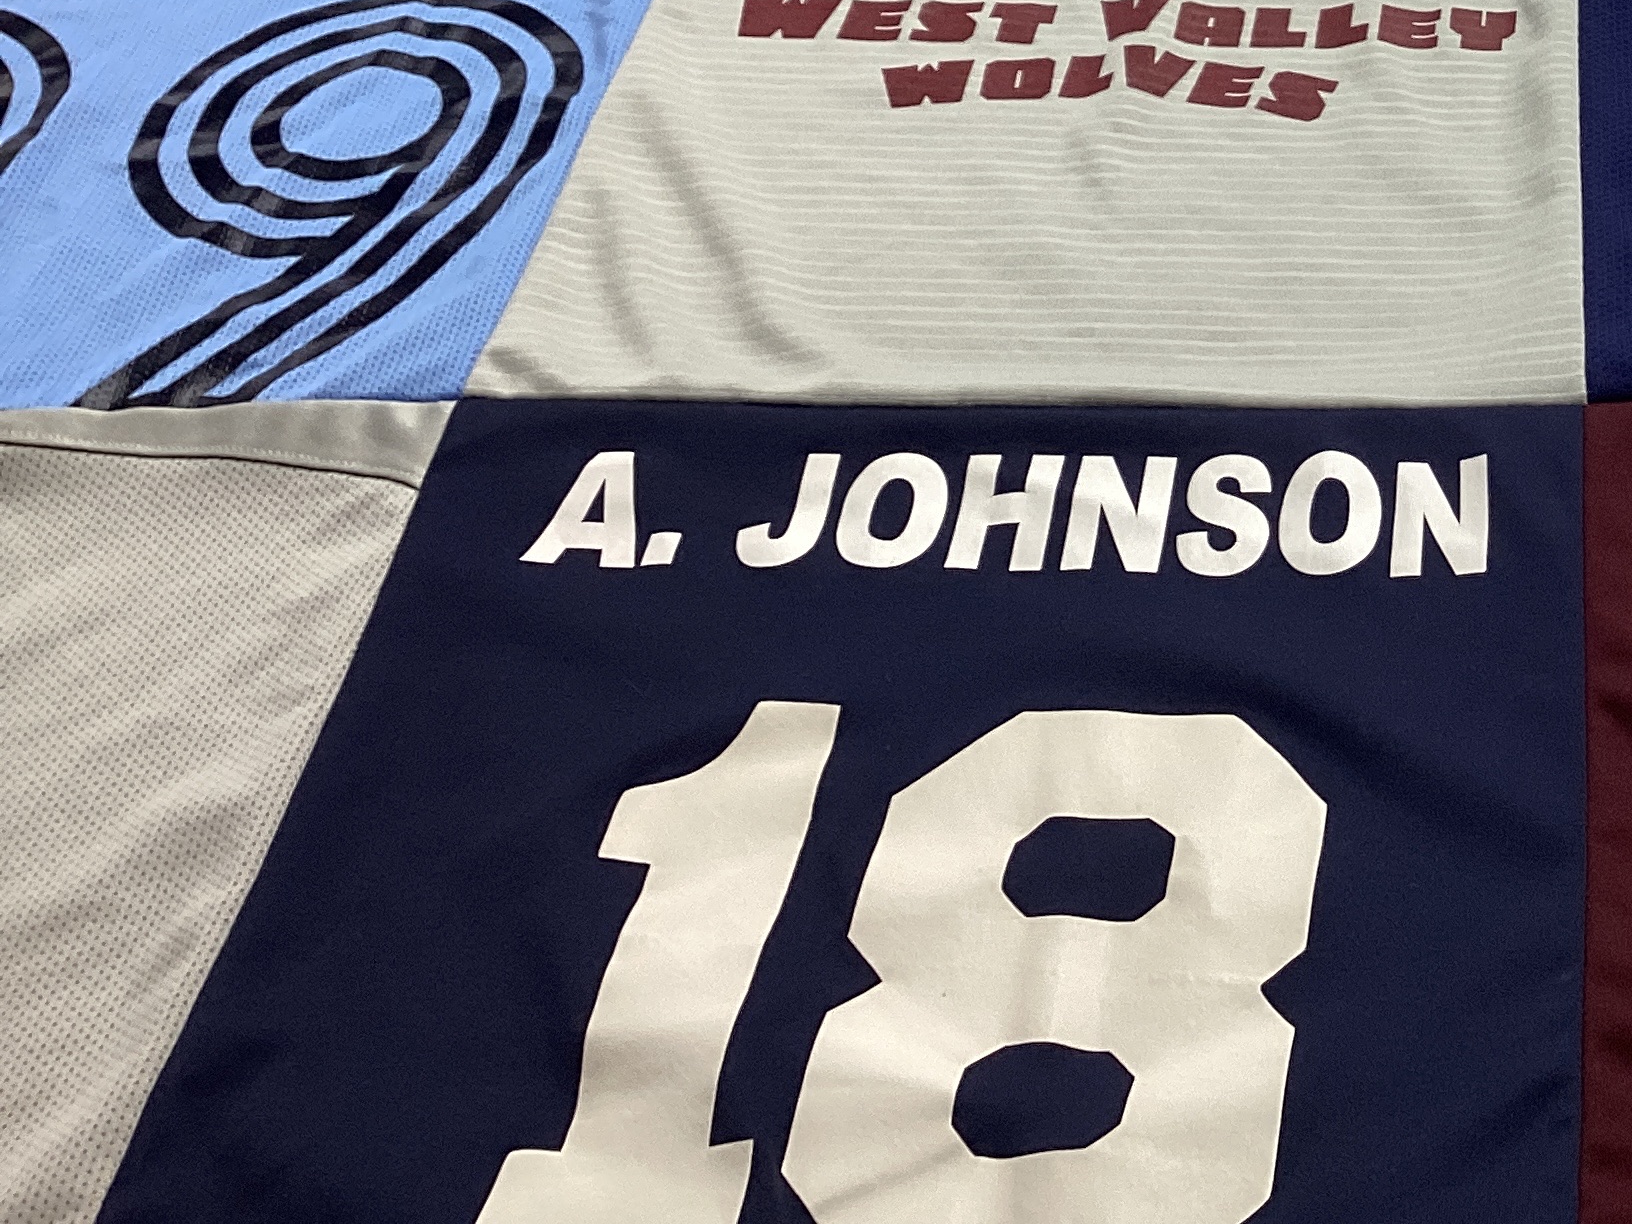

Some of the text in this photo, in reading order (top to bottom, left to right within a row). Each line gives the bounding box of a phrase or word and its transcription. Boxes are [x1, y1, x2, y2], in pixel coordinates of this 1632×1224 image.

[880, 44, 1340, 123] WOLVES
[519, 449, 1489, 579] A. JOHNSON
[474, 700, 1329, 1224] 18
